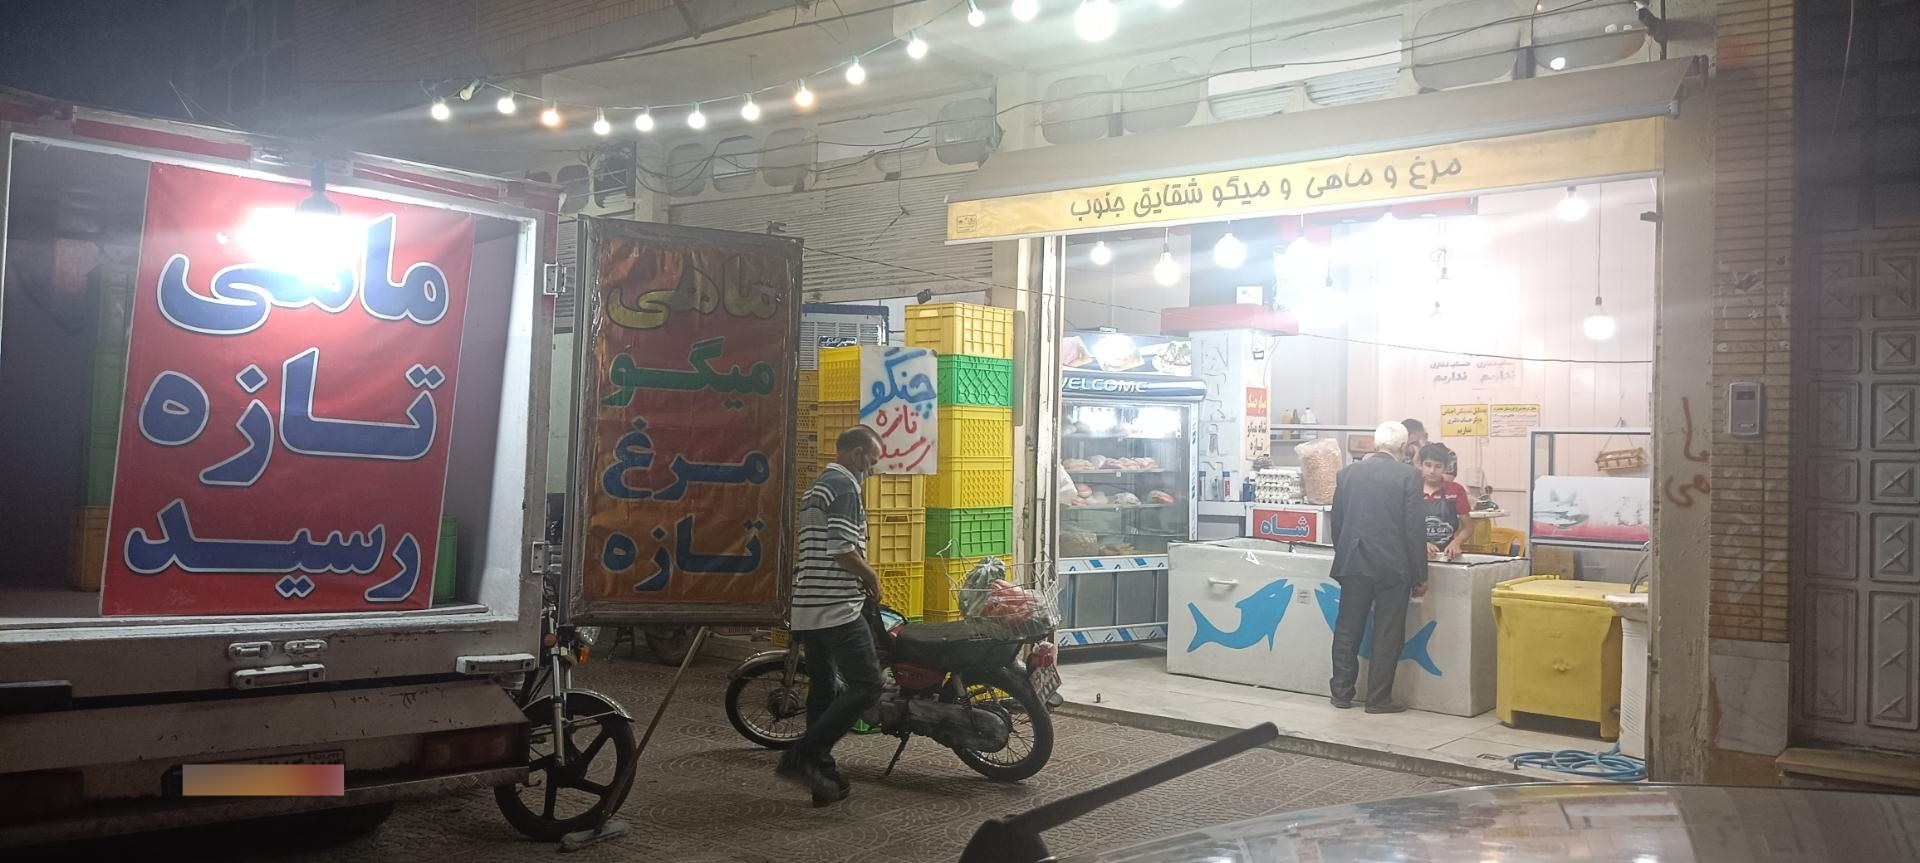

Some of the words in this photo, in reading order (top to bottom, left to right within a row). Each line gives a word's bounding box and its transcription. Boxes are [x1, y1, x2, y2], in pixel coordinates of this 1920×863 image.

[1280, 177, 1292, 200] و
[1305, 162, 1374, 199] ماهی
[1383, 164, 1398, 189] و
[1409, 155, 1462, 190] مرغ
[1070, 191, 1125, 221] جنوب
[1133, 177, 1203, 218] شقایق
[1212, 175, 1270, 207] میگو
[607, 255, 777, 330] ماهی
[601, 336, 776, 410] میگو
[1433, 370, 1469, 385] نداریم
[139, 346, 445, 487] تازه
[876, 404, 919, 438] تازه
[602, 416, 770, 503] مرغ
[1260, 513, 1310, 537] شاه
[124, 498, 422, 602] رسید
[602, 512, 765, 592] تازه
